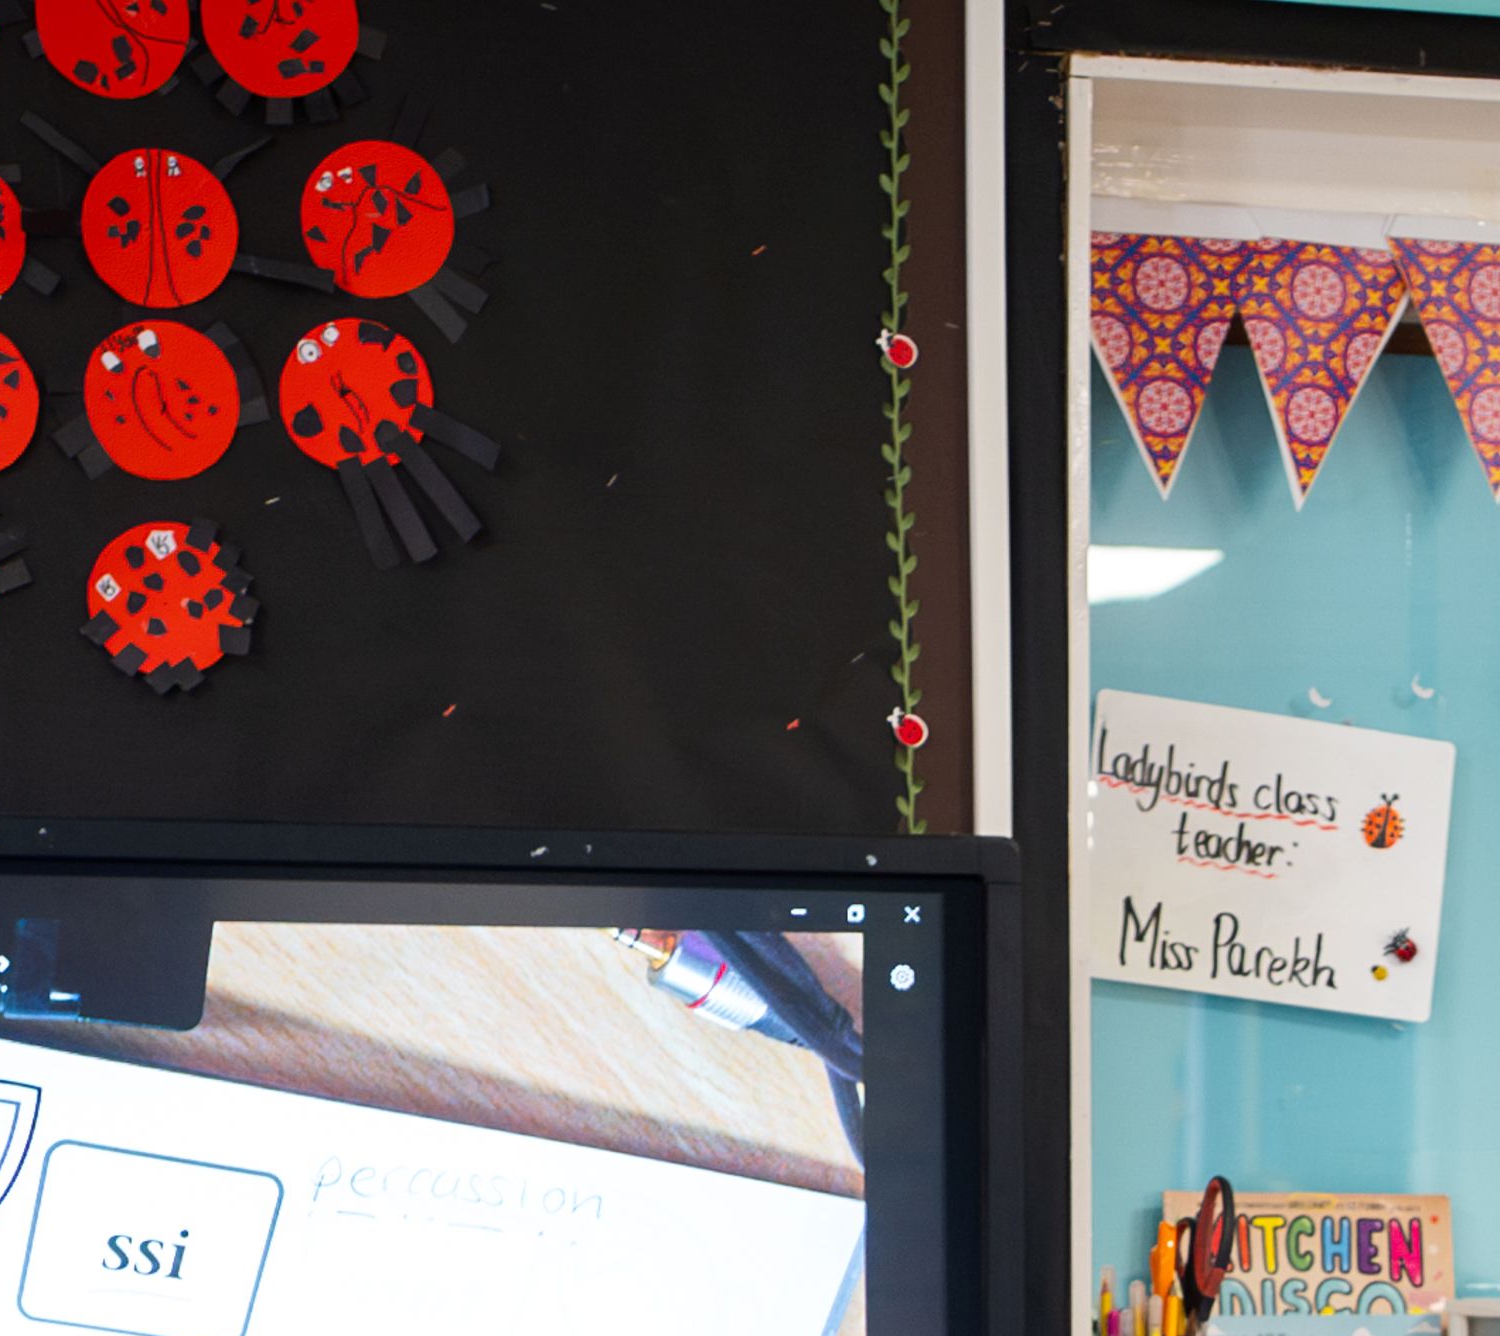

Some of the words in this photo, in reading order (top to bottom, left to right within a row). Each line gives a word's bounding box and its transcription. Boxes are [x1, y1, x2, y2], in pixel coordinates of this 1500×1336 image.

[1097, 728, 1238, 812] Ladybirds
[1252, 773, 1340, 822] class
[1171, 812, 1299, 869] teacher:
[1119, 895, 1200, 971] Miss
[1210, 912, 1340, 989] Parekh
[311, 1153, 606, 1221] percussion
[101, 1228, 193, 1282] ssi
[1219, 1277, 1409, 1316] DISCO
